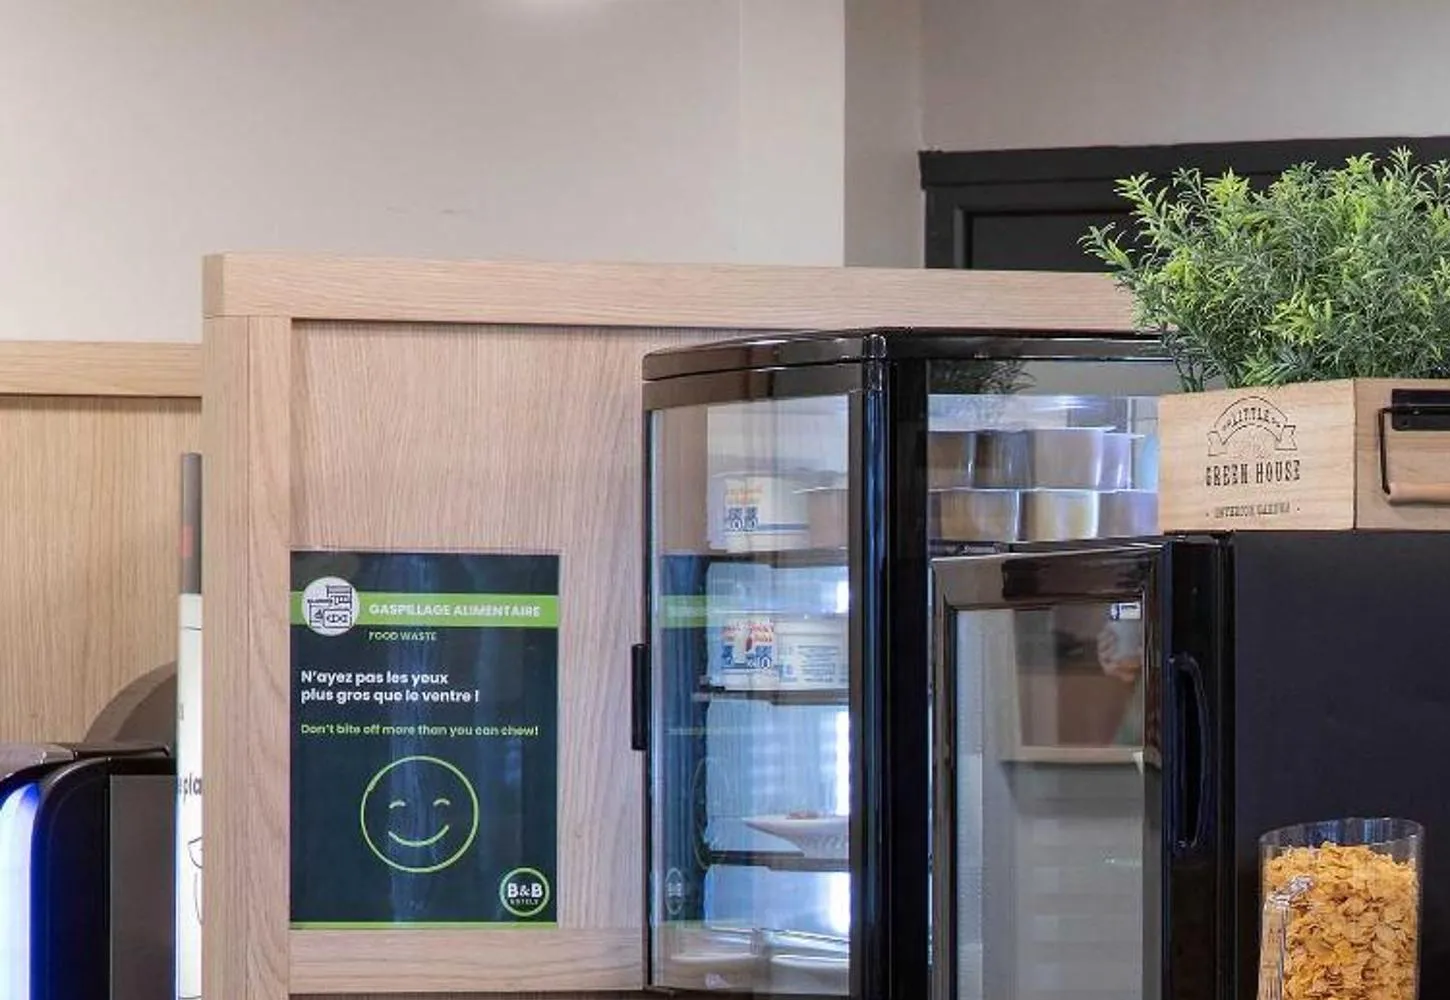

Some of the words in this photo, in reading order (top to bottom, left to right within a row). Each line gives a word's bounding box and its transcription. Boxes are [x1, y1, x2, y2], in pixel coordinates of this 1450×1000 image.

[1230, 407, 1271, 426] LITTLE
[1206, 463, 1248, 487] GREEN
[1256, 460, 1300, 484] HOUSE
[369, 604, 450, 616] GASPILLAGE
[453, 605, 540, 617] ALIMENTAIRE
[368, 631, 398, 641] FOOD
[401, 632, 437, 641] WASTE
[301, 671, 352, 686] N'ayez
[355, 673, 383, 687] pas
[386, 671, 408, 683] les
[411, 673, 448, 687] yeux
[301, 688, 333, 704] plus
[336, 691, 370, 704] gros
[373, 691, 402, 704] que
[405, 689, 419, 701] le
[421, 690, 471, 702] ventre
[301, 724, 333, 736] Don't
[336, 724, 361, 736] bite
[363, 724, 380, 736] off
[382, 726, 414, 736] more
[418, 724, 447, 736] than
[450, 727, 472, 738] you
[475, 727, 498, 736] can
[508, 882, 543, 898] B&B
